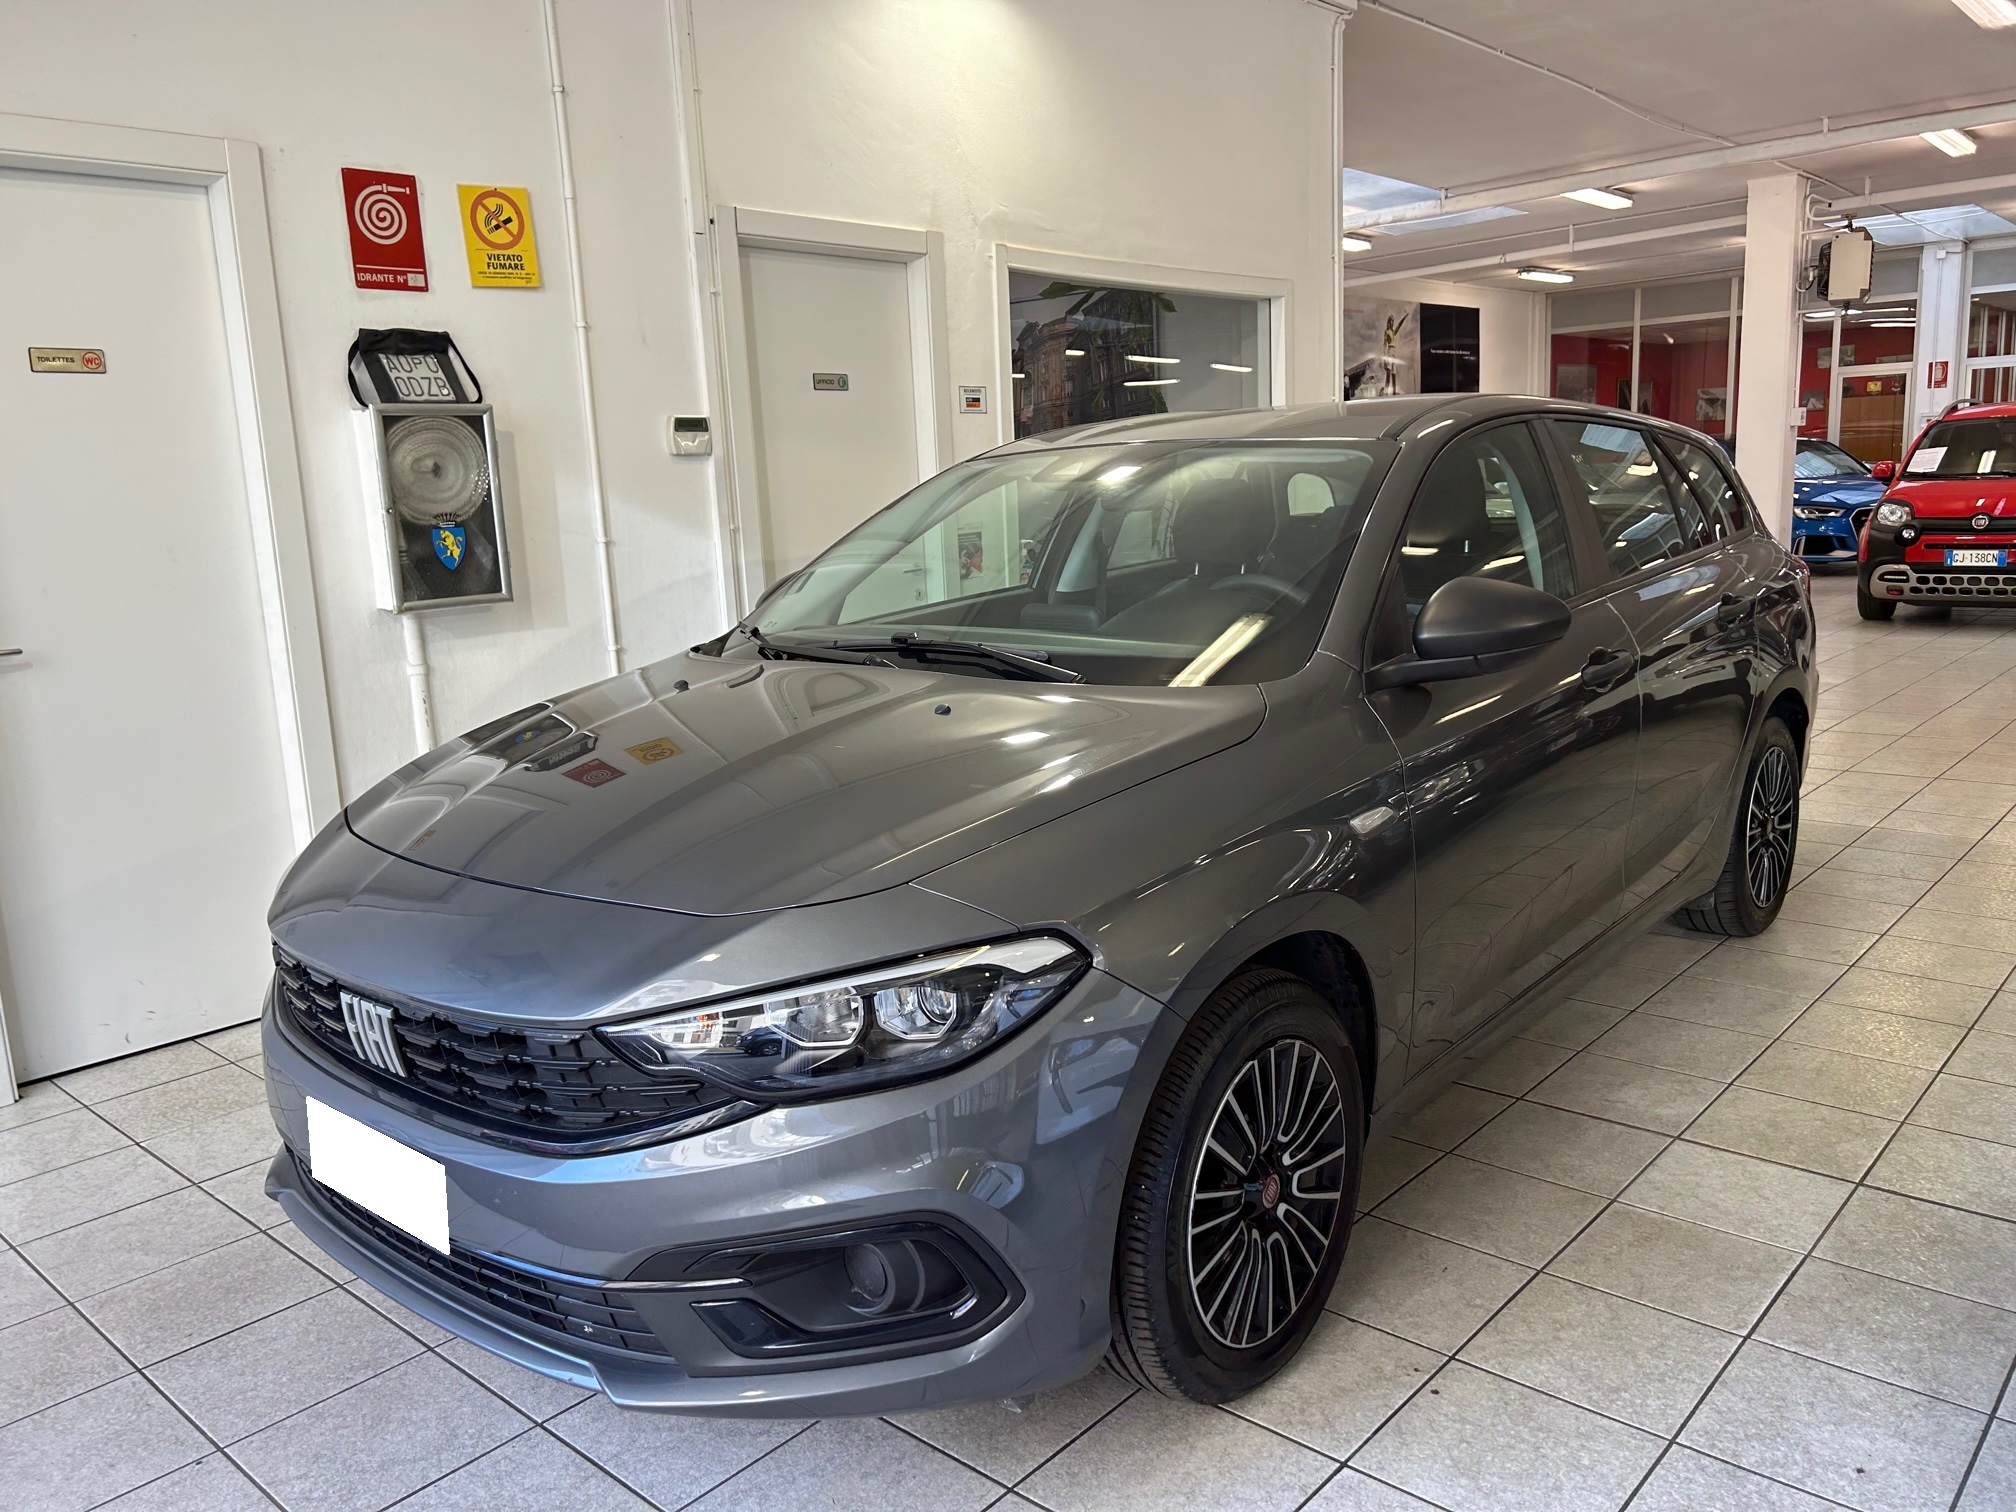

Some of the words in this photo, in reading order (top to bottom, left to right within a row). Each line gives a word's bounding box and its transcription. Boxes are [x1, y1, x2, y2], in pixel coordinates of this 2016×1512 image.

[486, 253, 523, 262] VIETATO
[486, 262, 526, 271] FUMARE
[357, 272, 395, 283] IDRANTE
[85, 357, 100, 365] WC
[340, 991, 407, 1077] FIAT
